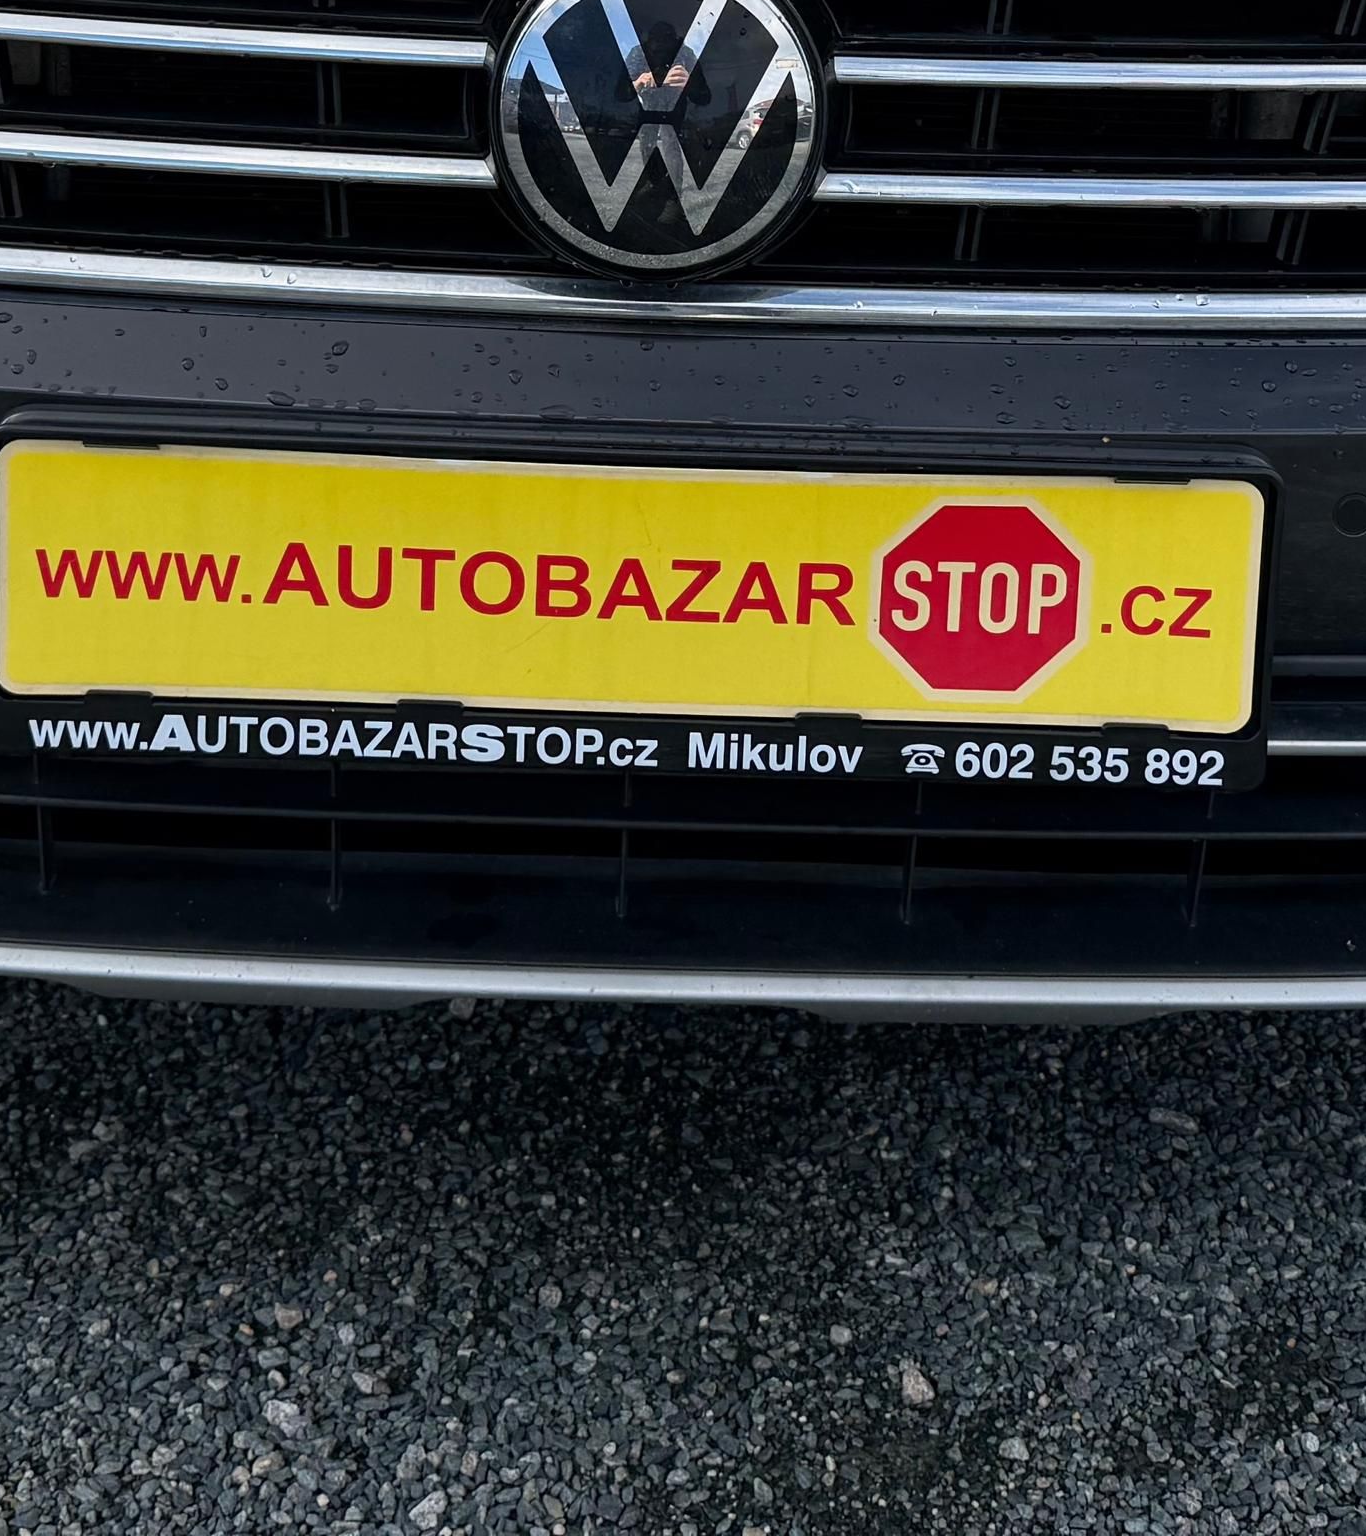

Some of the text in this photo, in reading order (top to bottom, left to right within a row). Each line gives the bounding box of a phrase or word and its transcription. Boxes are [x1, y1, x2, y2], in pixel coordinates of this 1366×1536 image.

[890, 559, 1068, 635] STOP
[687, 730, 864, 774] Mikulov
[954, 741, 1035, 781] 602
[1048, 745, 1130, 784] 535
[1143, 748, 1225, 787] 892
